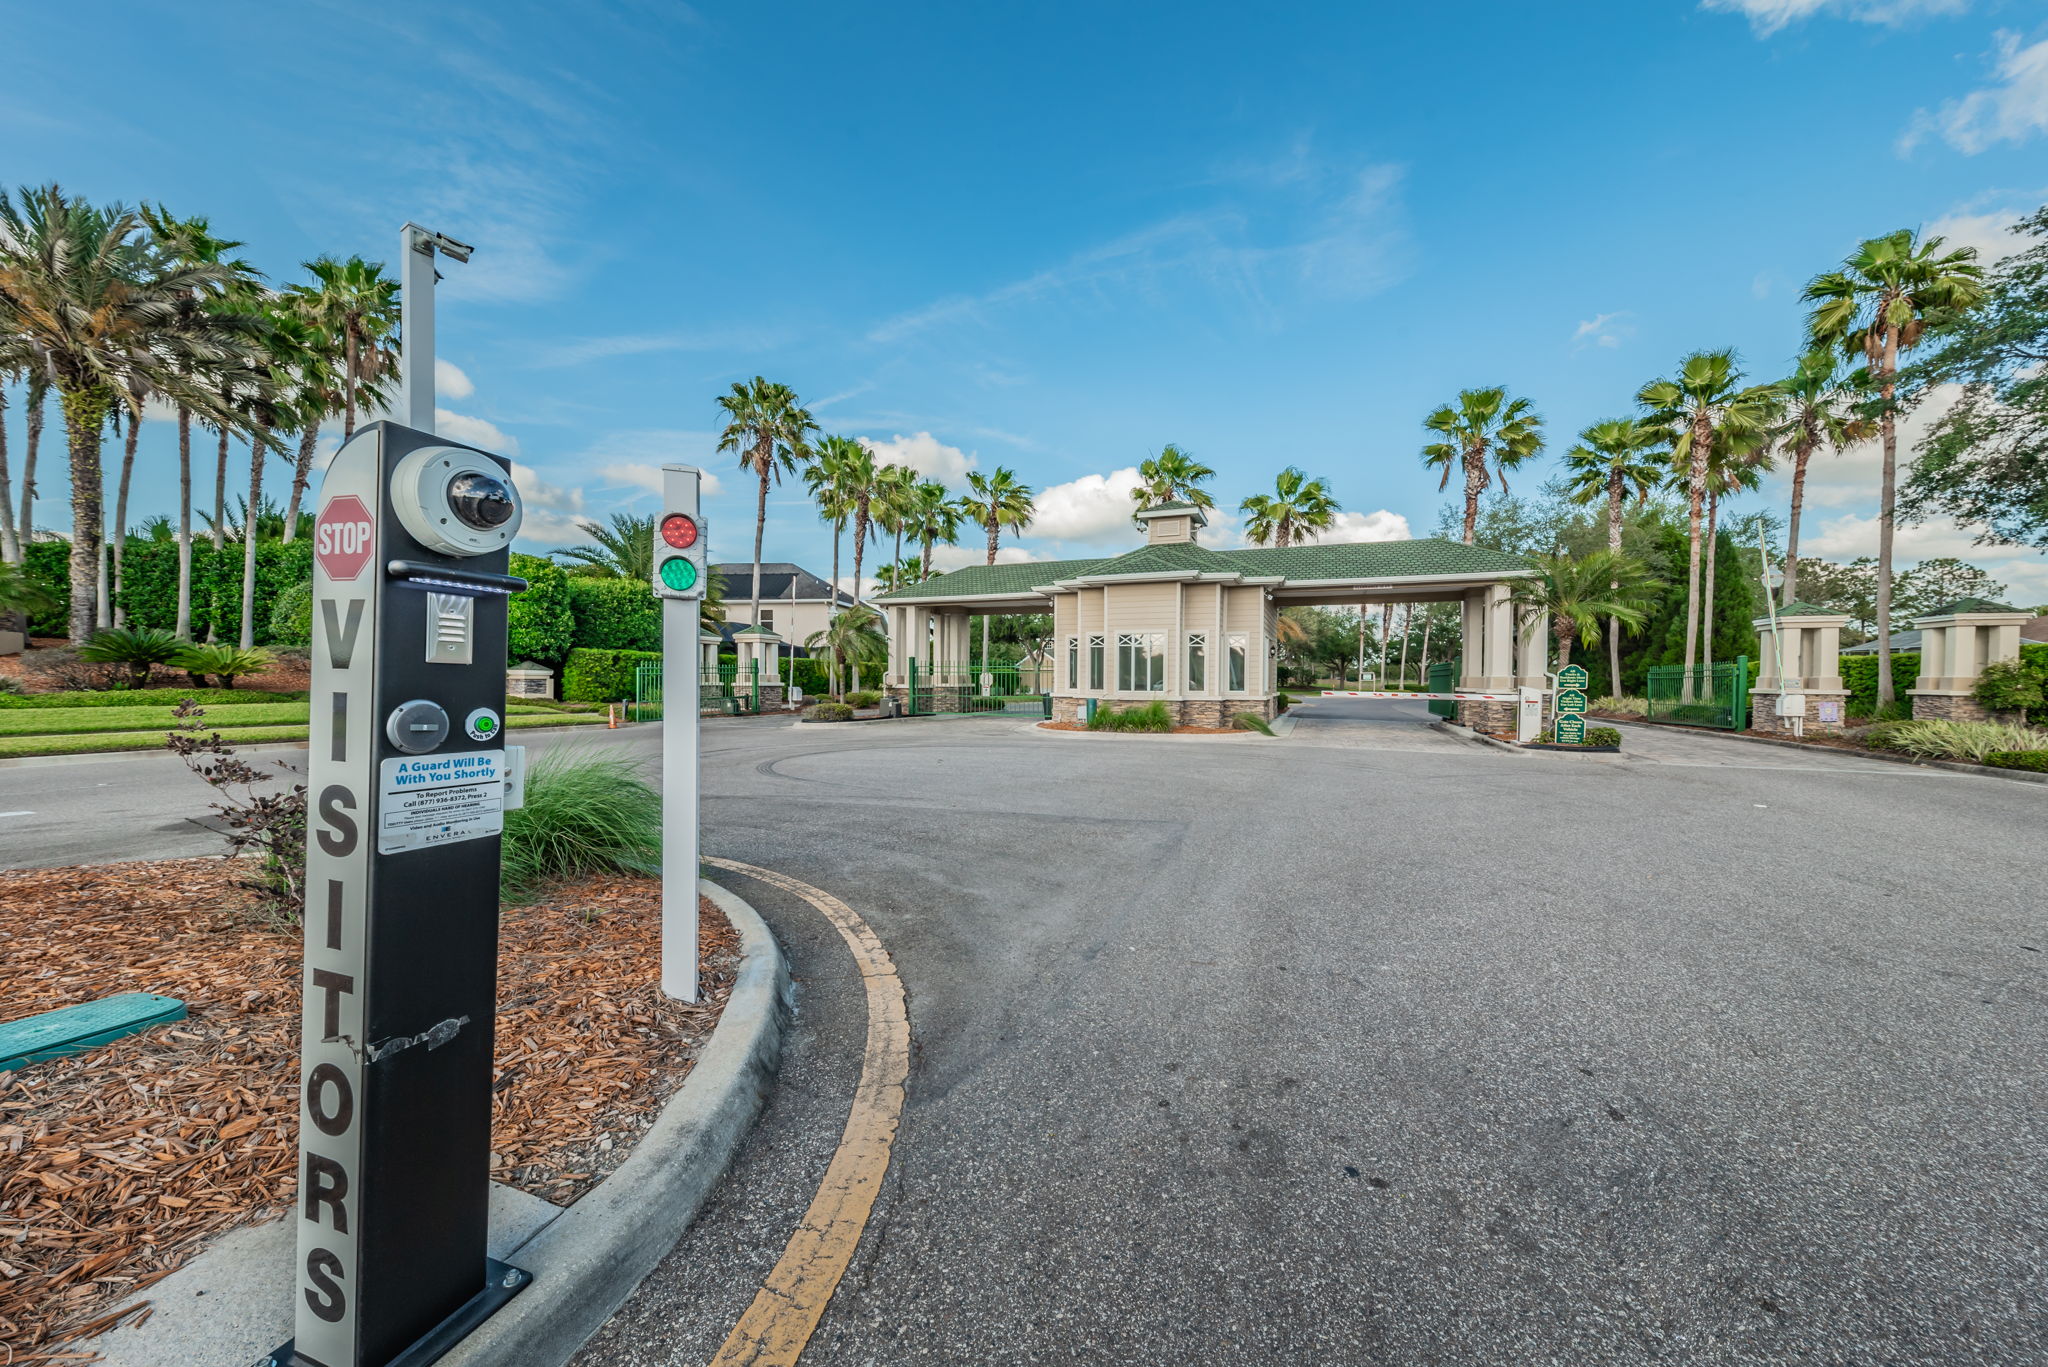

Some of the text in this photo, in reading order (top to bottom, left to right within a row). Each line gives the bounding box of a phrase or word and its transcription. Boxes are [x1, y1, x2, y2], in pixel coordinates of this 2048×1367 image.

[318, 521, 371, 555] STOP
[470, 730, 484, 739] Push
[398, 757, 492, 773] A Guard Will Be
[395, 767, 496, 785] With You Shortly
[403, 800, 417, 808] Call
[417, 798, 435, 807] (877)
[467, 793, 482, 801] Press
[425, 790, 448, 799] Report
[448, 787, 478, 796] Problems
[304, 599, 365, 1323] VISITORS
